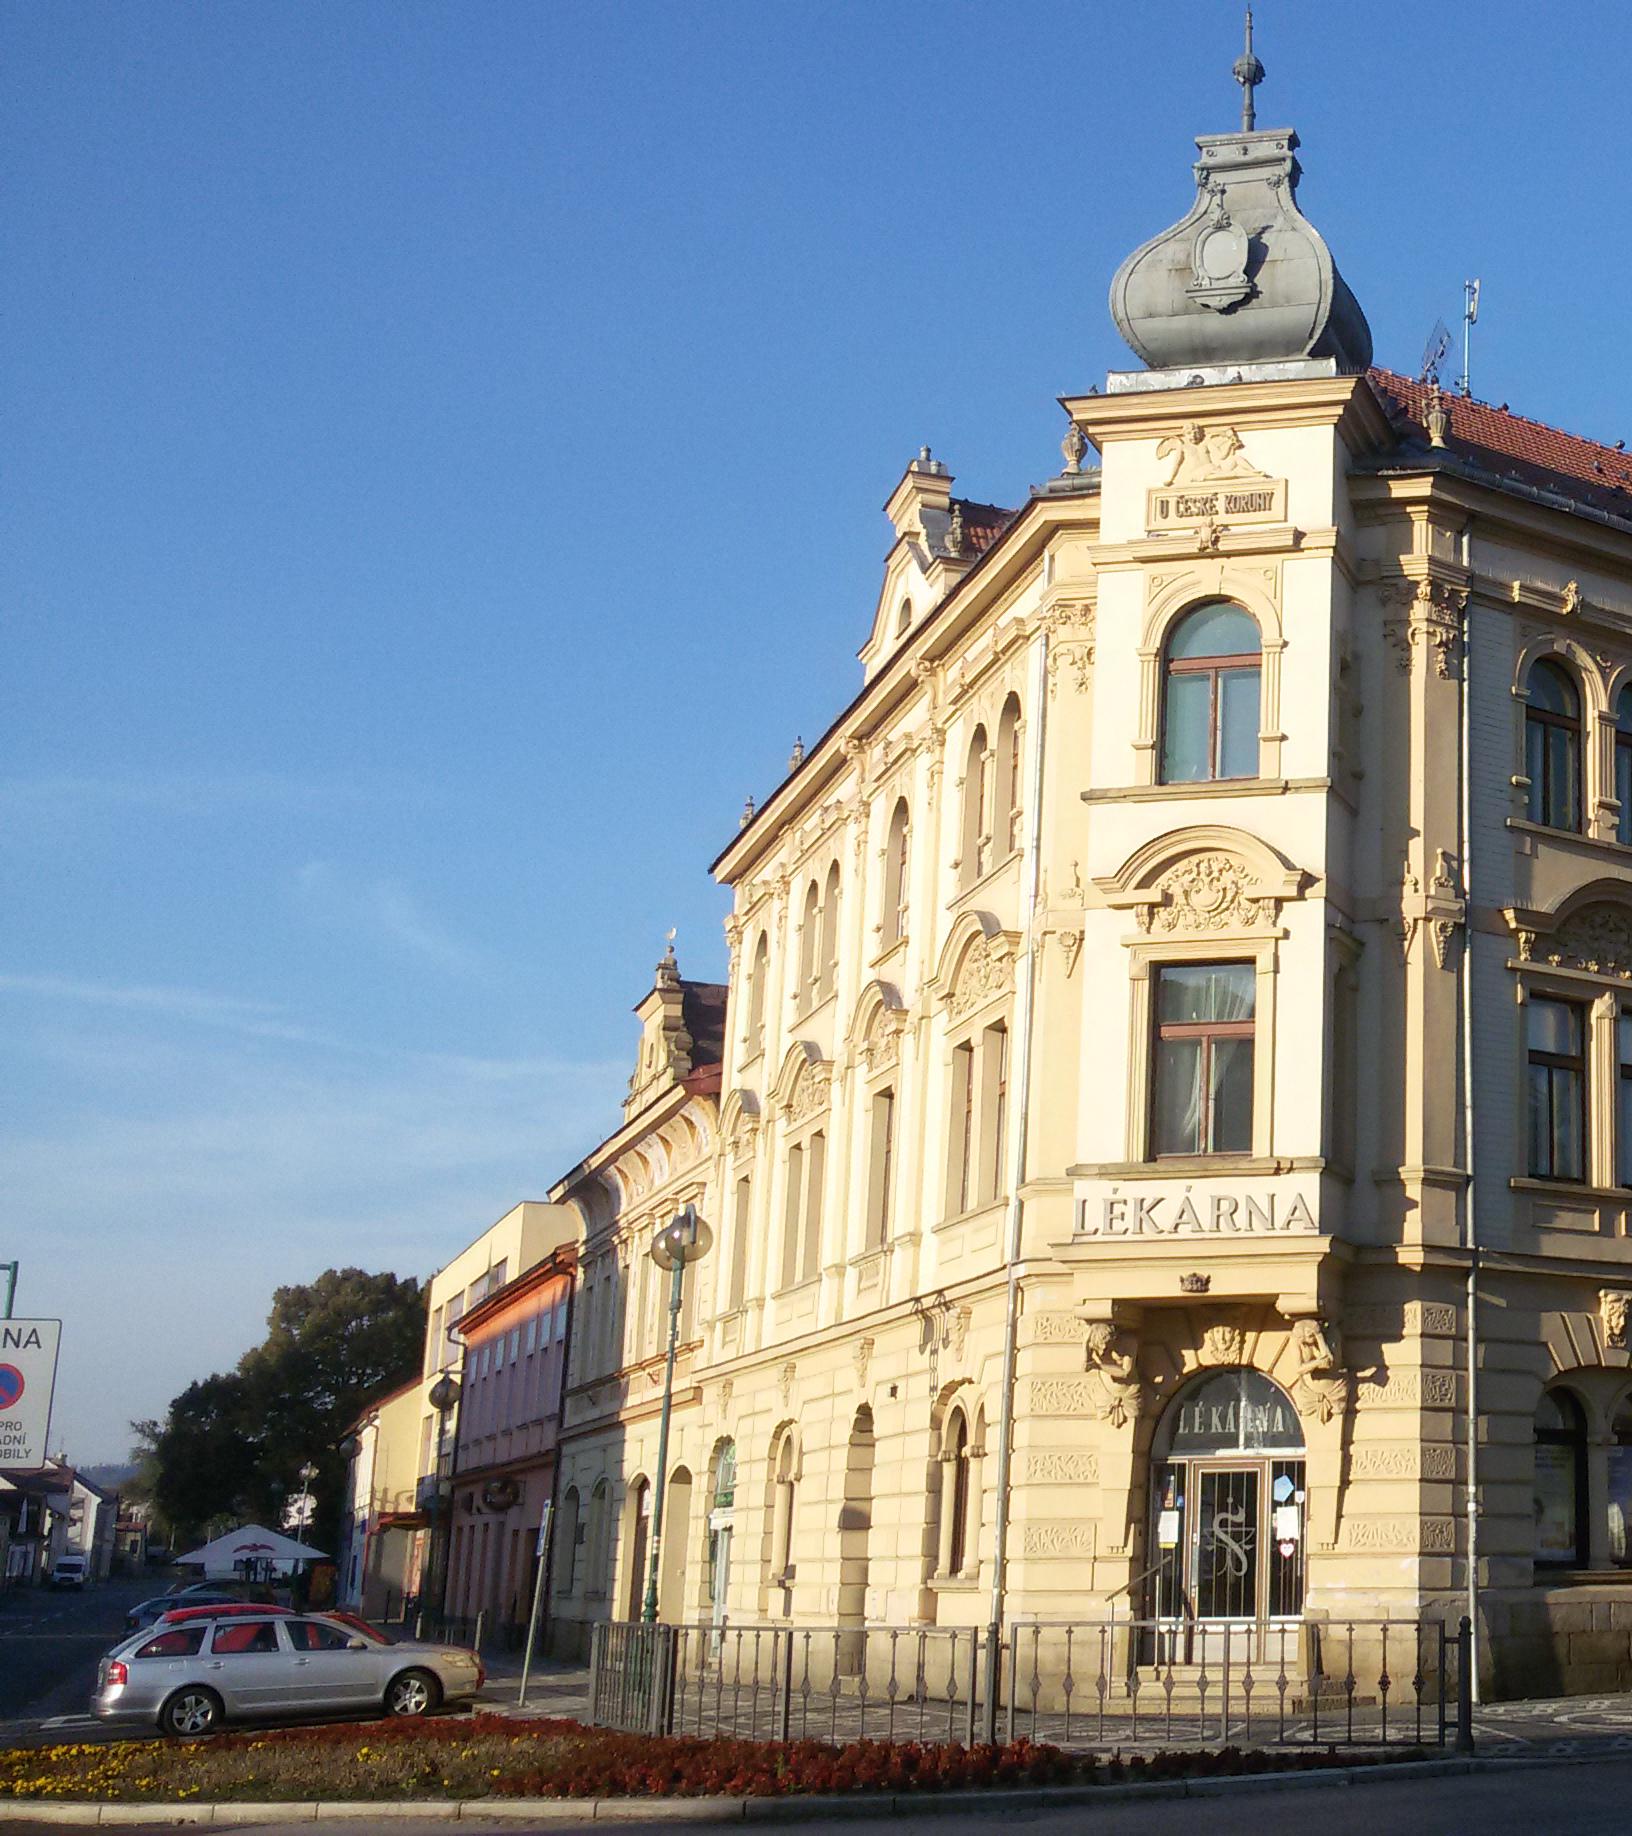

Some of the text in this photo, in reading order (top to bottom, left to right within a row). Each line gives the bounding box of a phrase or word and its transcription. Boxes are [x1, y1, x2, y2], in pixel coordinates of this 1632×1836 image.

[1159, 491, 1275, 520] U ČESKÉ KORUNY
[1074, 1185, 1319, 1236] LÉKÁRNA
[3, 1327, 42, 1349] NA
